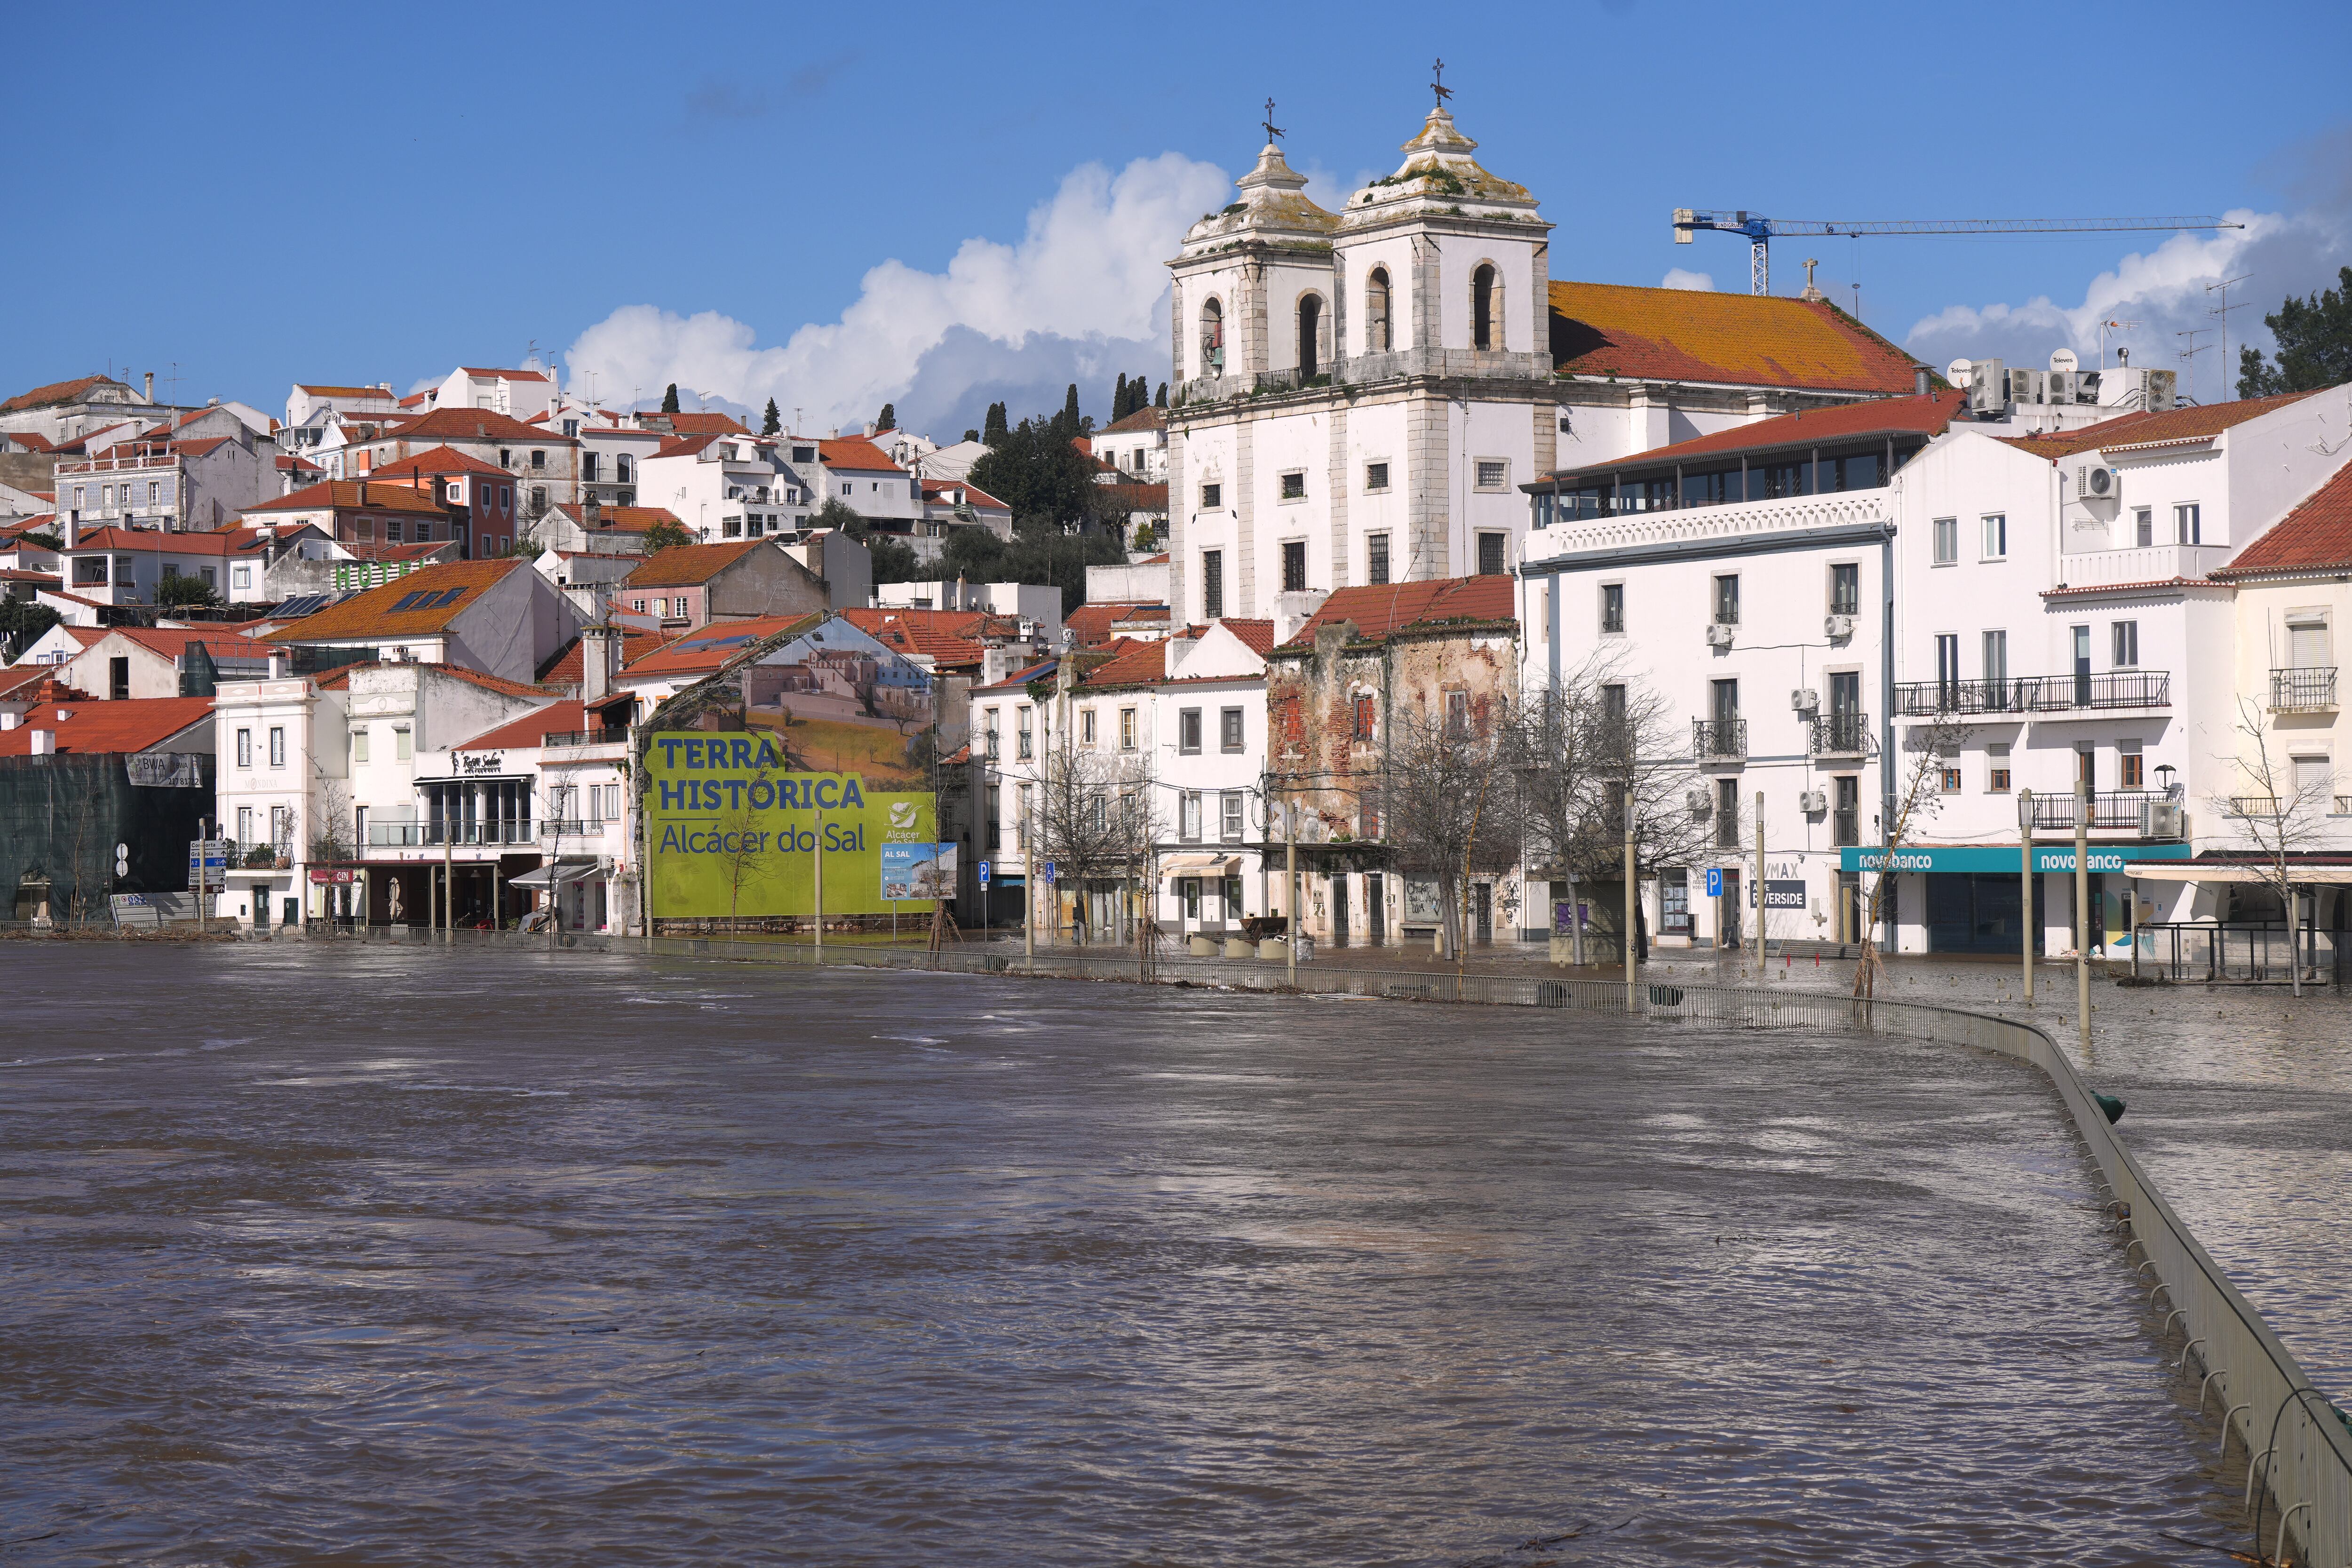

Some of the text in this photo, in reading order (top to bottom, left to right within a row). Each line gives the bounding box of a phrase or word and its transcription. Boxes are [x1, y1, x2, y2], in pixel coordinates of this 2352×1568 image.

[659, 739, 779, 769] TERRA
[143, 758, 165, 770] BWA
[245, 777, 278, 790] MONDINA
[659, 771, 865, 810] HISTÓRICA
[660, 823, 866, 853] Alcácer do Sal
[886, 830, 920, 839] Alcácer
[2041, 855, 2122, 869] novoanco
[337, 872, 349, 882] CIN
[981, 864, 987, 881] P
[1749, 863, 1799, 878] R/MAX
[1710, 871, 1719, 893] P
[1753, 892, 1803, 905] RVERSIDE
